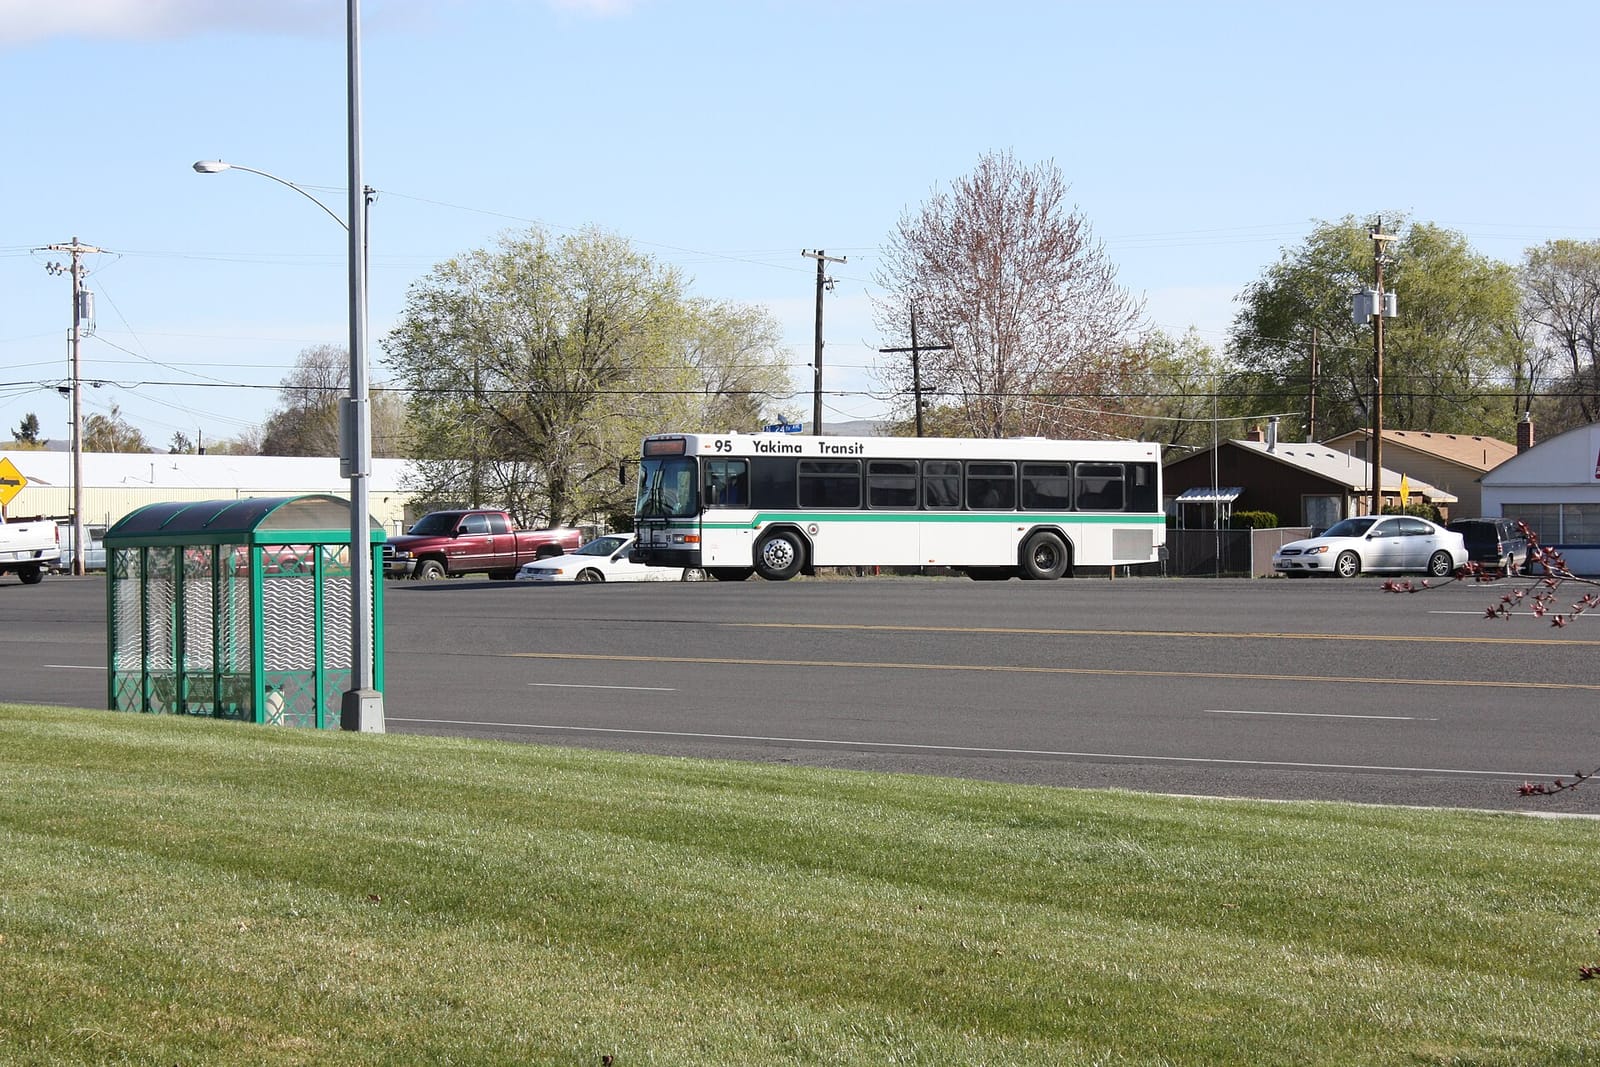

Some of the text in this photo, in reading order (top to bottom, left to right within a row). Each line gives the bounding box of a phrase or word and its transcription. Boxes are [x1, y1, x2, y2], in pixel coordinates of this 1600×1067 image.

[714, 440, 864, 454] 95 Yakima Transit
